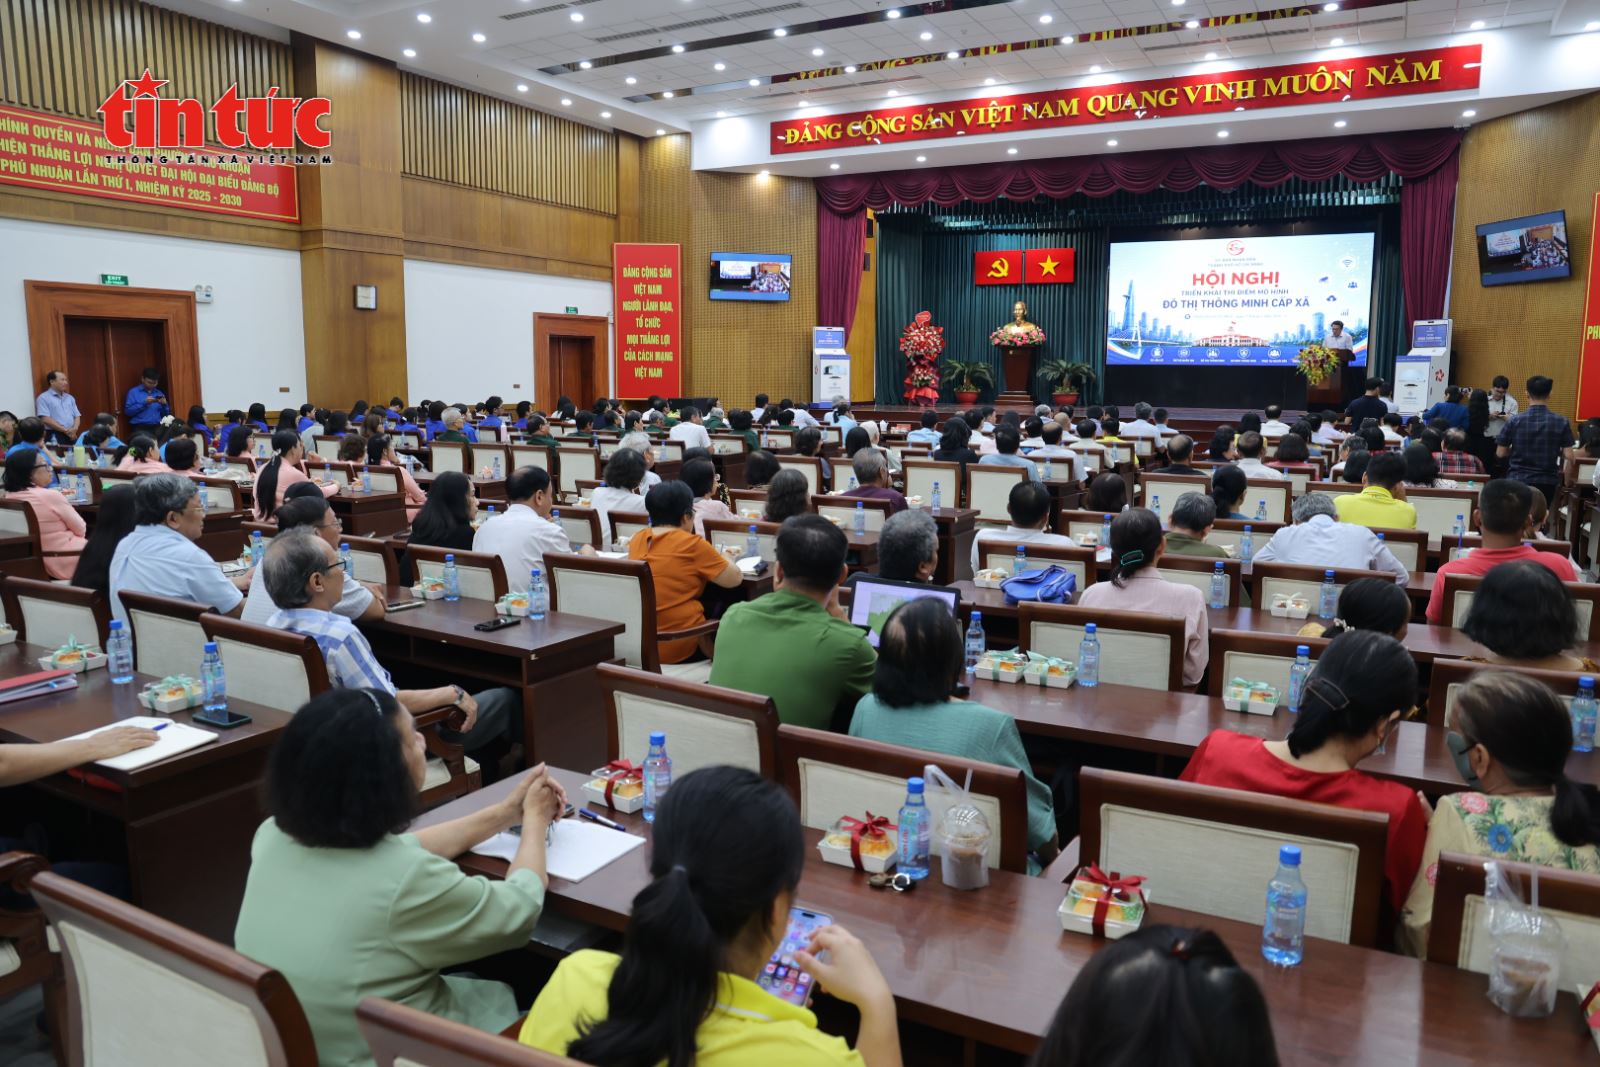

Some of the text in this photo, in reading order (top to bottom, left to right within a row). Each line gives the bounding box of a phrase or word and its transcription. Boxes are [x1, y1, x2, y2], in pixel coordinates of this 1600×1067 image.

[784, 58, 1443, 145] ĐẢNG CỘNG SẢN VIỆT NAM QUANG VINH MUÔN NĂM
[76, 130, 91, 147] VÀ
[30, 140, 71, 162] THẮNG
[74, 150, 93, 168] LỢI
[160, 165, 178, 182] ĐẠI
[180, 168, 197, 184] HỘI
[199, 173, 215, 188] ĐẠI
[218, 173, 239, 190] BIỂU
[241, 177, 265, 194] ĐẢNG
[267, 183, 280, 198] BỘ
[0, 158, 27, 174] PHÚ
[30, 164, 73, 183] NHUẬN
[76, 169, 98, 185] LẦN
[102, 174, 123, 189] THỨ
[136, 180, 170, 198] NHIỆM
[188, 188, 211, 203] 2025
[220, 193, 242, 207] 2030
[622, 263, 672, 280] ĐẢNG CỘNG SẢN
[1192, 269, 1280, 289] HỘI NGHỊ
[633, 282, 663, 297] VIỆT NAM
[1180, 299, 1198, 311] THỊ
[1201, 296, 1238, 309] THÔNG
[1241, 298, 1269, 308] MINH
[1271, 295, 1293, 308] CẤP
[1295, 294, 1311, 307] XÃ
[645, 316, 661, 329] CHỨC
[626, 334, 638, 347] MỌI
[639, 330, 660, 345] THẮNG
[623, 347, 637, 361] CỦA
[637, 348, 654, 361] CÁCH
[634, 365, 663, 380] VIỆT NAM
